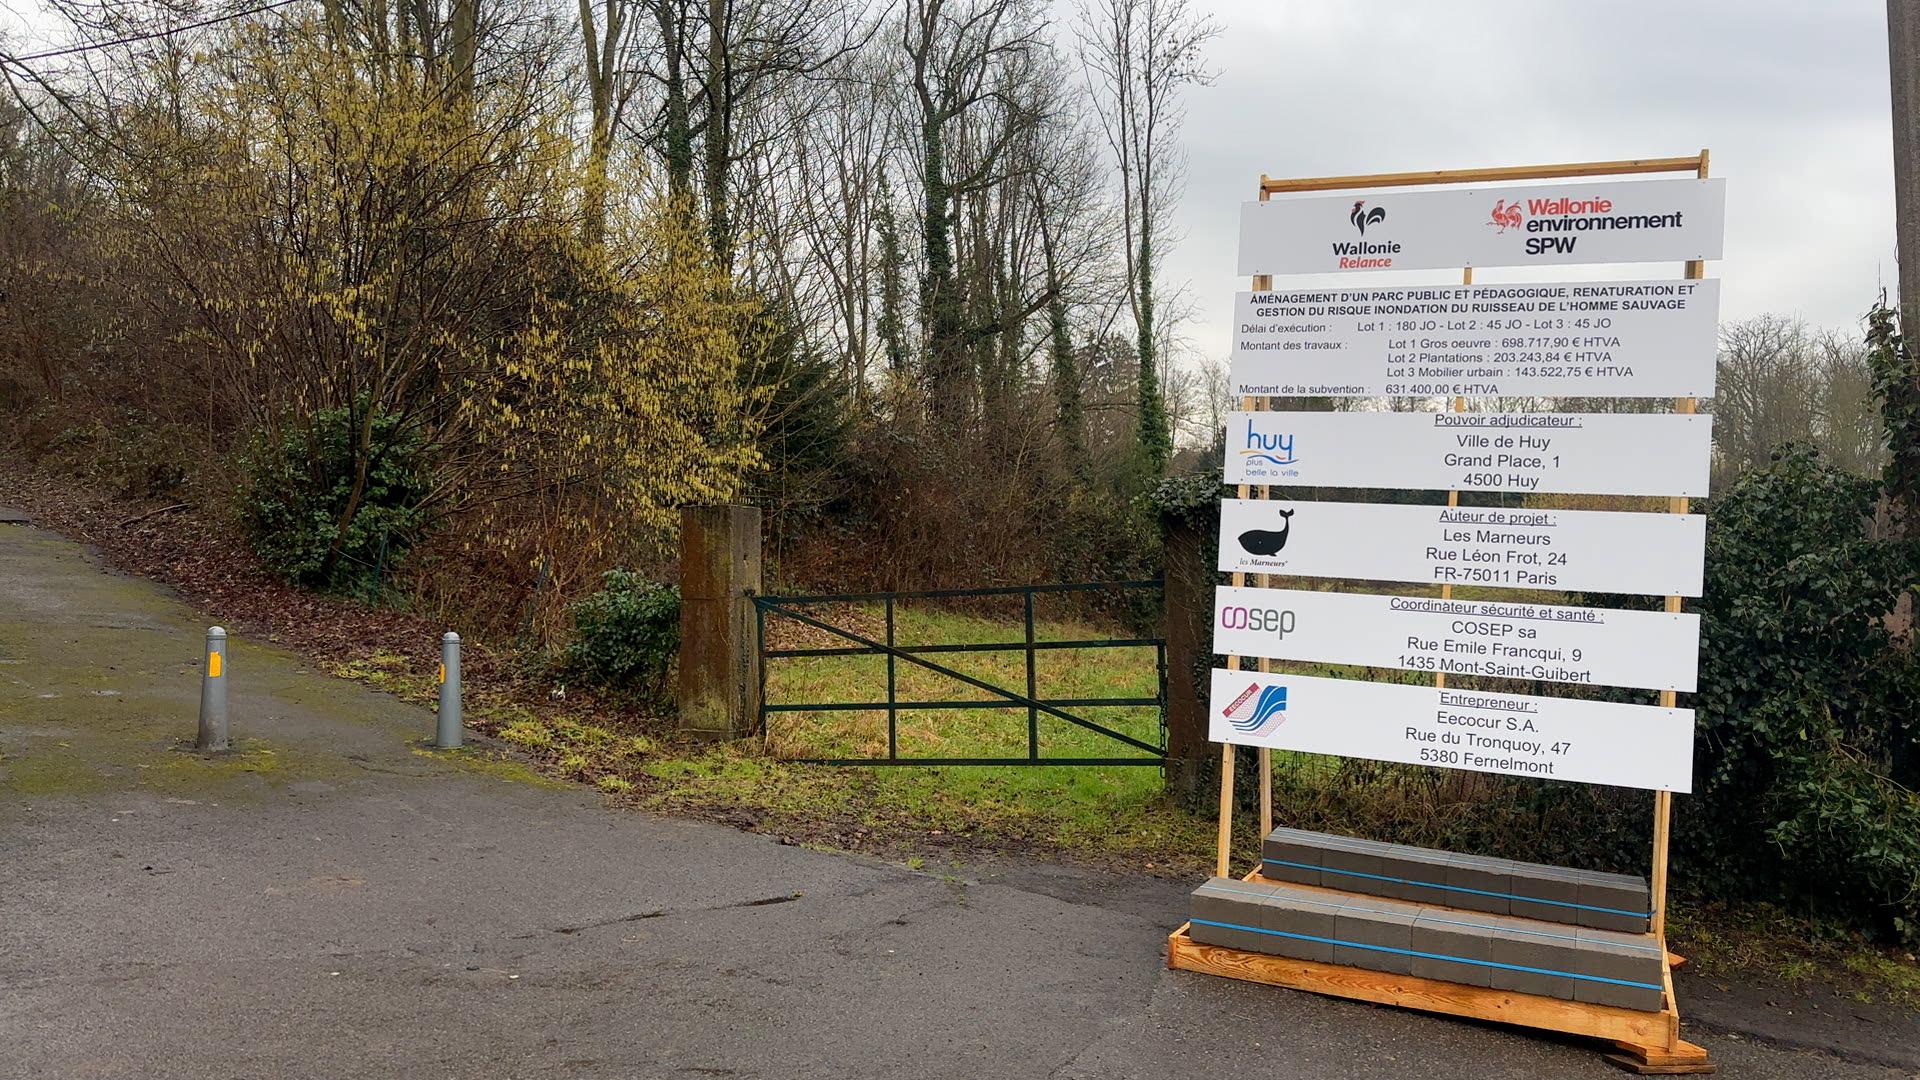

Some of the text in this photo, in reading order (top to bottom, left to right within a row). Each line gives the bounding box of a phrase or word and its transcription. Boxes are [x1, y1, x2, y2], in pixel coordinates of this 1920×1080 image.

[1528, 197, 1612, 216] Wallonie
[1526, 211, 1683, 233] environnement
[1333, 241, 1401, 255] Wallonie
[1525, 236, 1577, 255] SPW
[1339, 256, 1392, 269] Relance
[1250, 285, 1695, 304] AMÉNAGEMENT D'UN PARC PUBLIC ET PÉDAGOGIQUE, RENATURATION ET
[1256, 299, 1686, 317] GESTION DU RISQUE INONDATION DU RUISSEAU DE L'HOMME SAUVAGE
[1241, 324, 1266, 334] Délai
[1269, 324, 1326, 333] d'exécution
[1357, 322, 1374, 332] Lot
[1379, 321, 1383, 331] 1
[1397, 321, 1417, 331] 180
[1419, 321, 1436, 331] JO
[1447, 320, 1466, 330] Lot
[1469, 320, 1476, 330] 2
[1487, 319, 1501, 329] 45
[1505, 319, 1522, 329] JO
[1533, 319, 1552, 329] Lot
[1556, 319, 1564, 329] 3
[1575, 318, 1590, 328] 45
[1594, 318, 1611, 328] JO
[1240, 341, 1281, 351] Montant
[1283, 340, 1301, 350] des
[1304, 341, 1341, 350] travaux
[1389, 339, 1407, 349] Lot
[1410, 339, 1416, 348] 1
[1420, 338, 1447, 349] Gros
[1451, 340, 1491, 348] oeuvre
[1502, 338, 1568, 349] 698.717,90
[1572, 337, 1580, 347] €
[1584, 337, 1620, 347] HTVA
[1388, 353, 1407, 363] Lot
[1409, 353, 1417, 363] 2
[1419, 353, 1483, 363] Plantations
[1494, 353, 1560, 363] 203.243,84
[1564, 352, 1572, 362] €
[1576, 352, 1612, 362] HTVA
[1387, 368, 1406, 377] Lot
[1408, 368, 1415, 377] 3
[1418, 367, 1462, 377] Mobilier
[1467, 367, 1503, 377] urbain
[1515, 367, 1581, 378] 143.522,75
[1585, 367, 1593, 377] €
[1597, 367, 1633, 377] HTVA
[1239, 384, 1279, 394] Montant
[1282, 384, 1294, 394] de
[1297, 384, 1306, 393] la
[1308, 384, 1364, 394] subvention
[1385, 384, 1449, 395] 631.400,00
[1453, 384, 1461, 394] €
[1464, 384, 1499, 394] HTVA
[1434, 414, 1486, 426] Pouvoir
[1490, 415, 1574, 428] adjudicateur
[1247, 419, 1293, 460] huy
[1457, 434, 1551, 451] Ville de Huy
[1444, 453, 1560, 470] Grand Place, 1
[1463, 473, 1540, 491] 4500 Huy
[1439, 510, 1484, 523] Auteur
[1488, 512, 1505, 523] de
[1510, 513, 1549, 527] projet
[1444, 529, 1551, 545] Les Marneurs
[1426, 547, 1567, 566] Rue Léon Frot, 24
[1434, 567, 1557, 585] FR-75011 Paris
[1390, 598, 1477, 614] Coordinateur
[1481, 603, 1535, 618] sécurité
[1539, 607, 1552, 619] et
[1556, 609, 1595, 621] santé
[1222, 607, 1295, 640] cosep
[1451, 621, 1537, 639] COSEP sa
[1407, 637, 1582, 663] Rue Emile Francqui, 9
[1398, 655, 1591, 683] 1435 Mont-Saint-Guibert
[1440, 692, 1530, 711] Entrepreneur
[1437, 711, 1539, 732] Eecocur S.A.
[1405, 727, 1571, 756] Rue du Tronquoy, 47
[1420, 749, 1554, 774] 5380 Fernelmont
